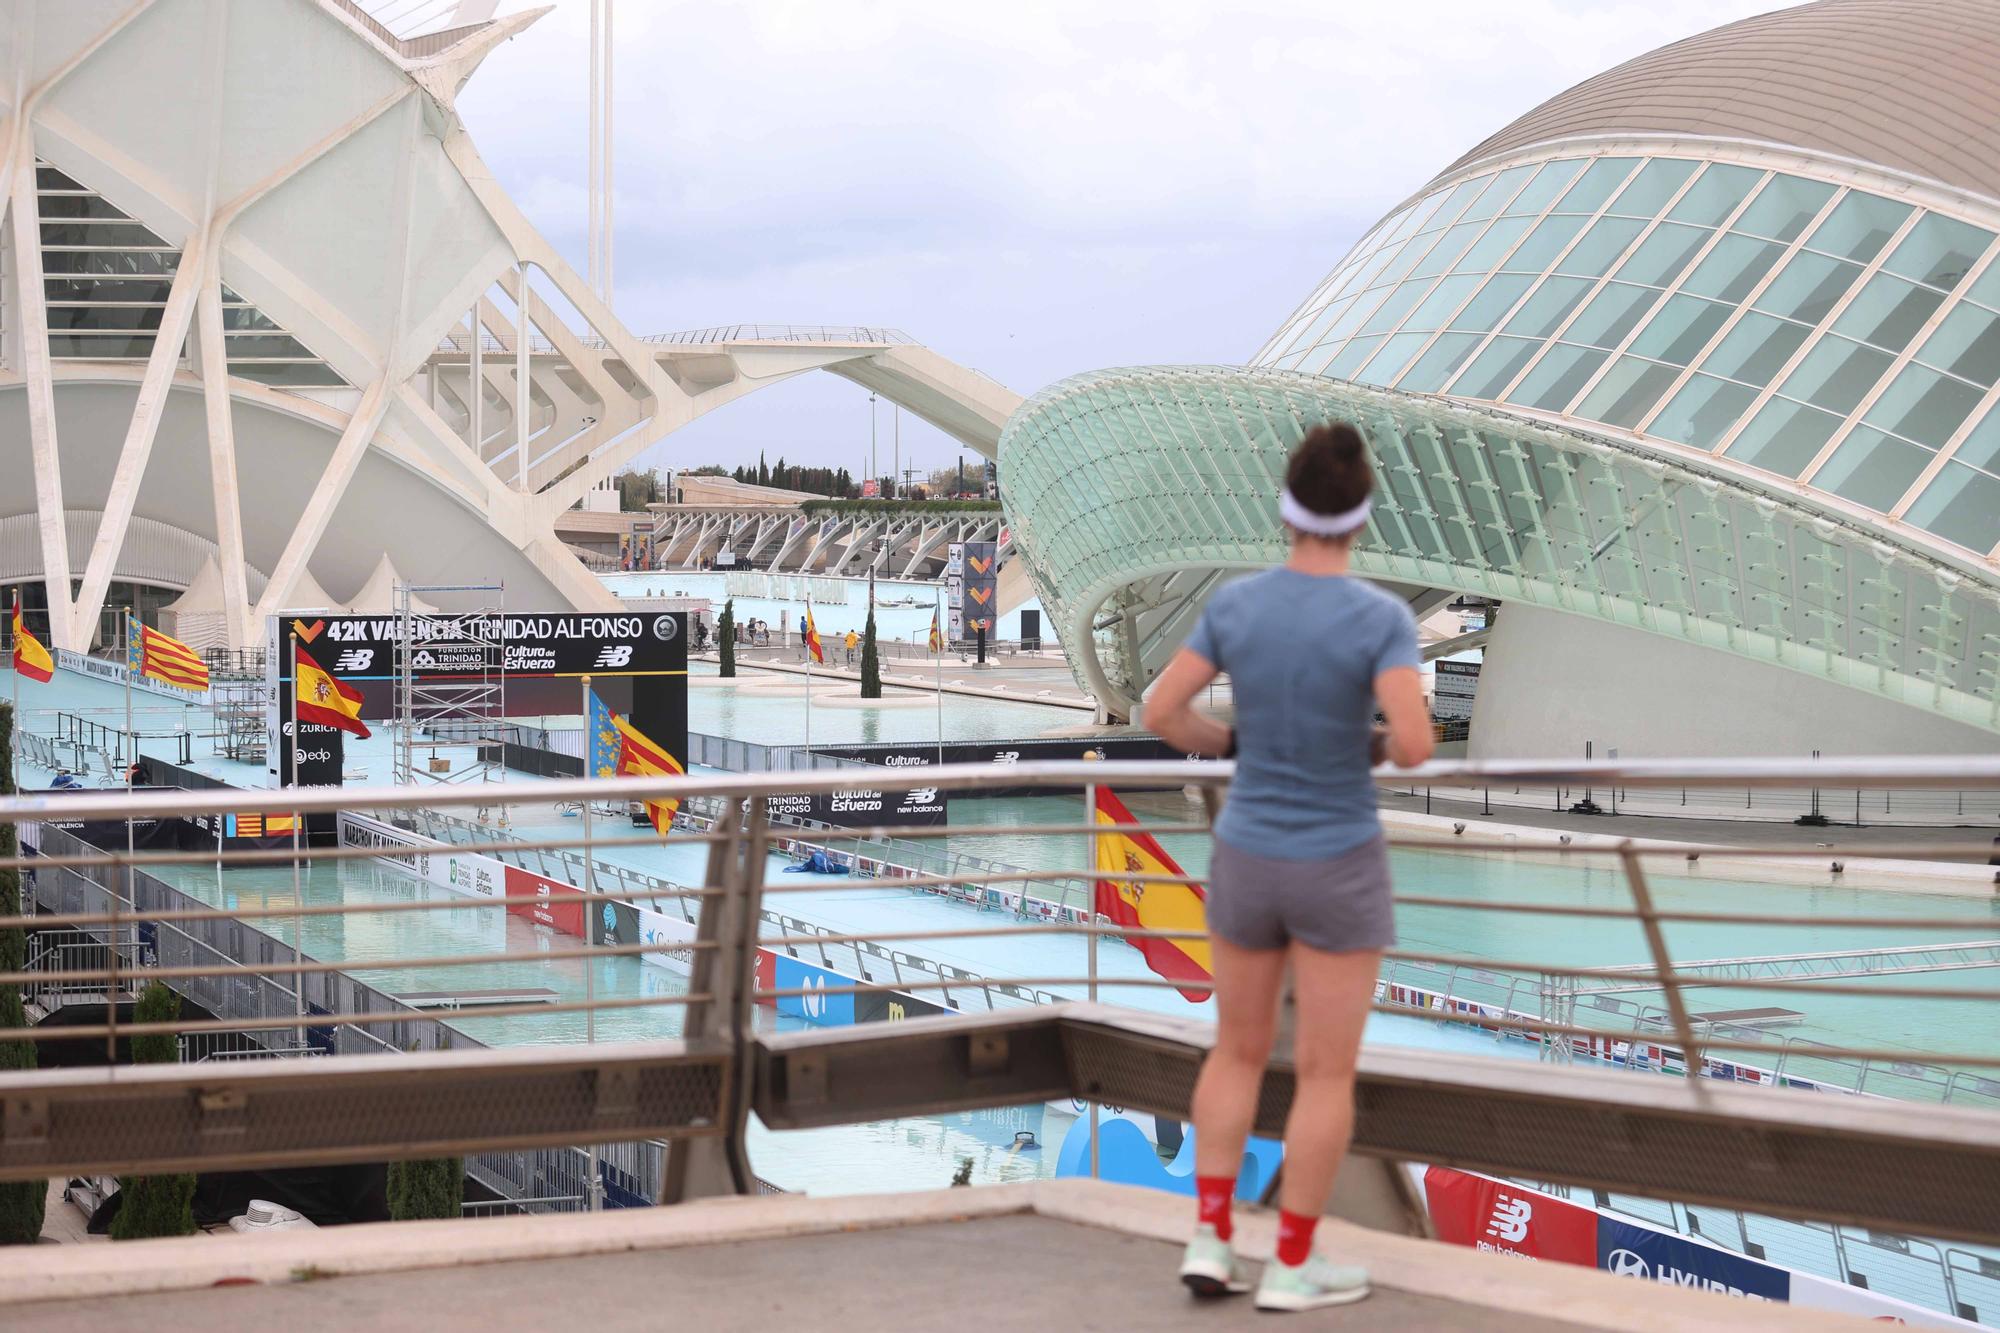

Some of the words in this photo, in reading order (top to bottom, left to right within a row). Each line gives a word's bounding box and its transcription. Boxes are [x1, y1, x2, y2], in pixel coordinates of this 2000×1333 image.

[327, 620, 367, 641] 42K
[466, 618, 552, 640] TRINIDAD
[554, 617, 643, 639] ALFONSO
[505, 645, 546, 658] Cultura
[438, 654, 482, 662] TRINIDAD
[503, 657, 556, 670] Esfuerzo
[300, 724, 337, 733] ZURICH
[307, 747, 331, 763] edp
[885, 755, 921, 767] Cultura
[920, 757, 929, 766] del
[832, 789, 872, 799] Cultura
[871, 791, 882, 799] del
[767, 796, 811, 805] TRINIDAD
[831, 799, 882, 812] Esfuerzo
[767, 804, 811, 814] ALFONSO
[912, 804, 944, 813] balance
[1476, 1240, 1496, 1254] new
